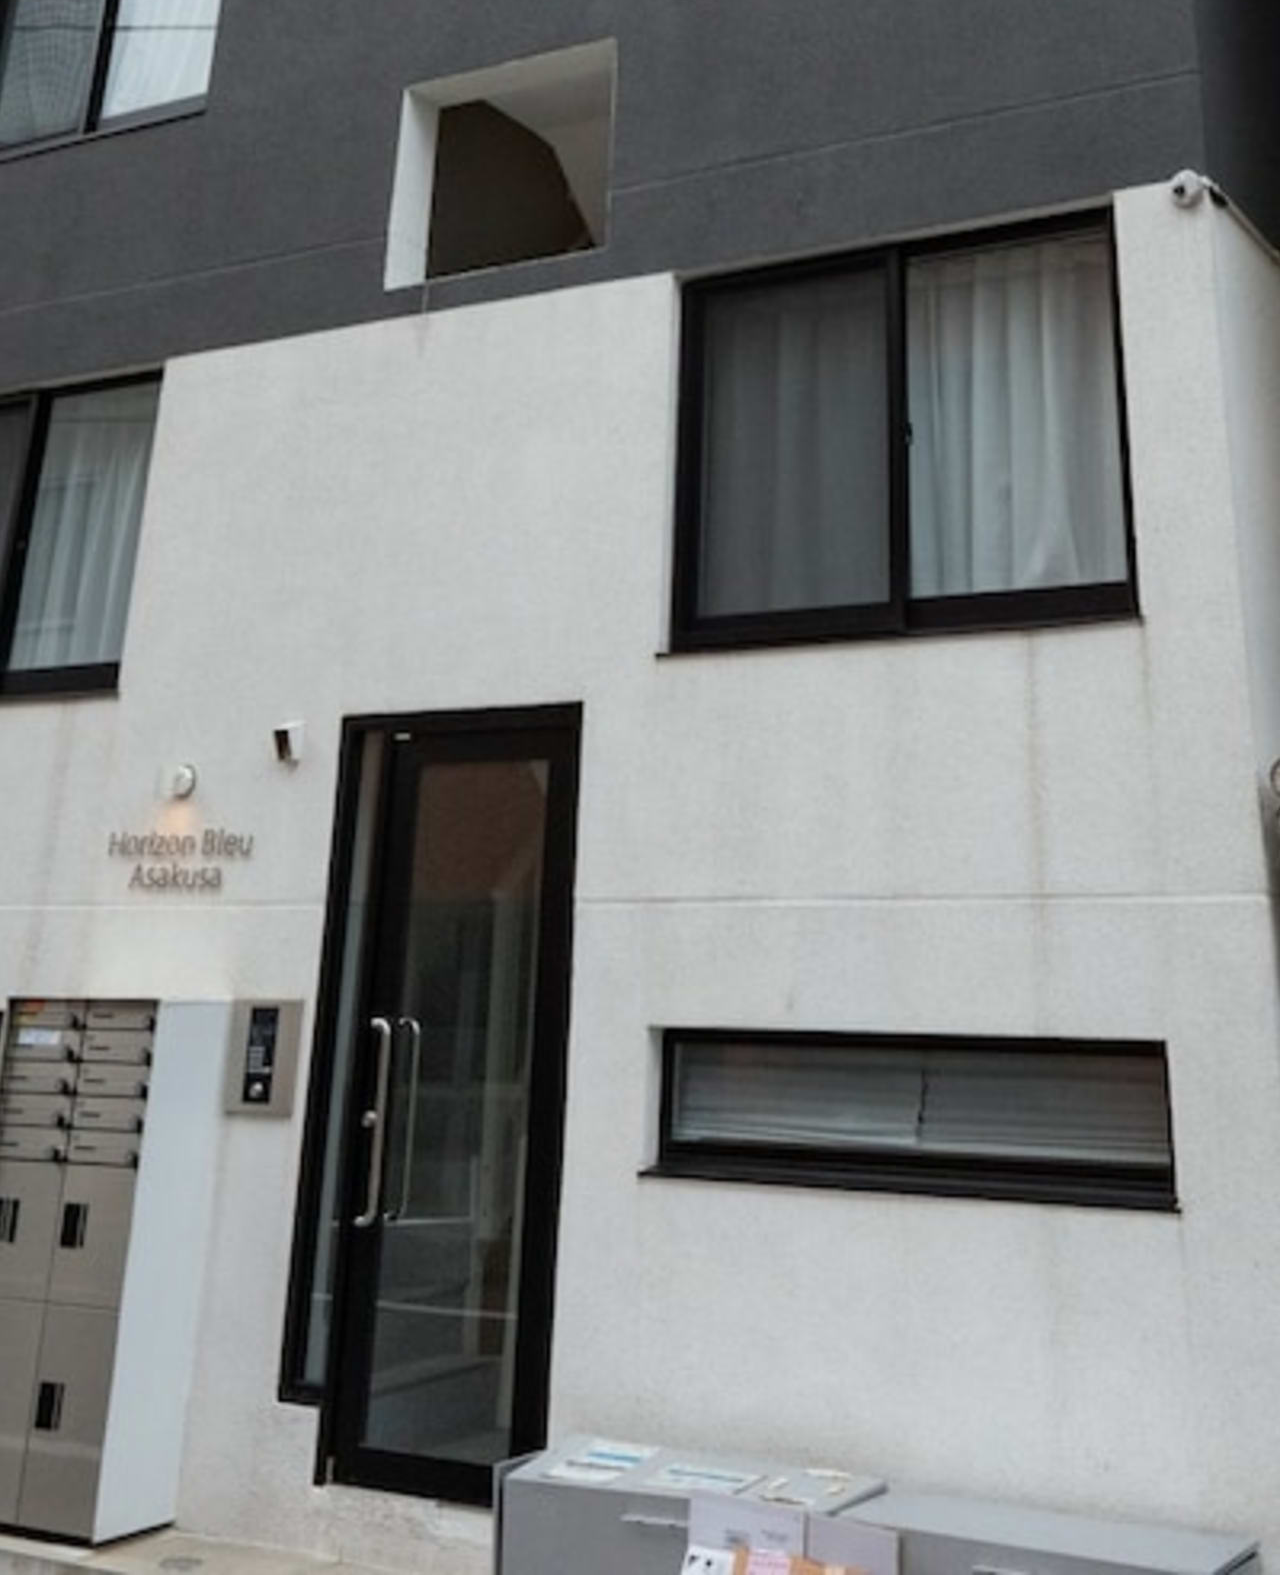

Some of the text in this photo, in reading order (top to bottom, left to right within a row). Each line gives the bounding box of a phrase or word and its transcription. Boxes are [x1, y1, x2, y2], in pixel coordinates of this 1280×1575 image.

[108, 827, 254, 858] Horizon Bleu
[128, 863, 223, 890] Asakusa
